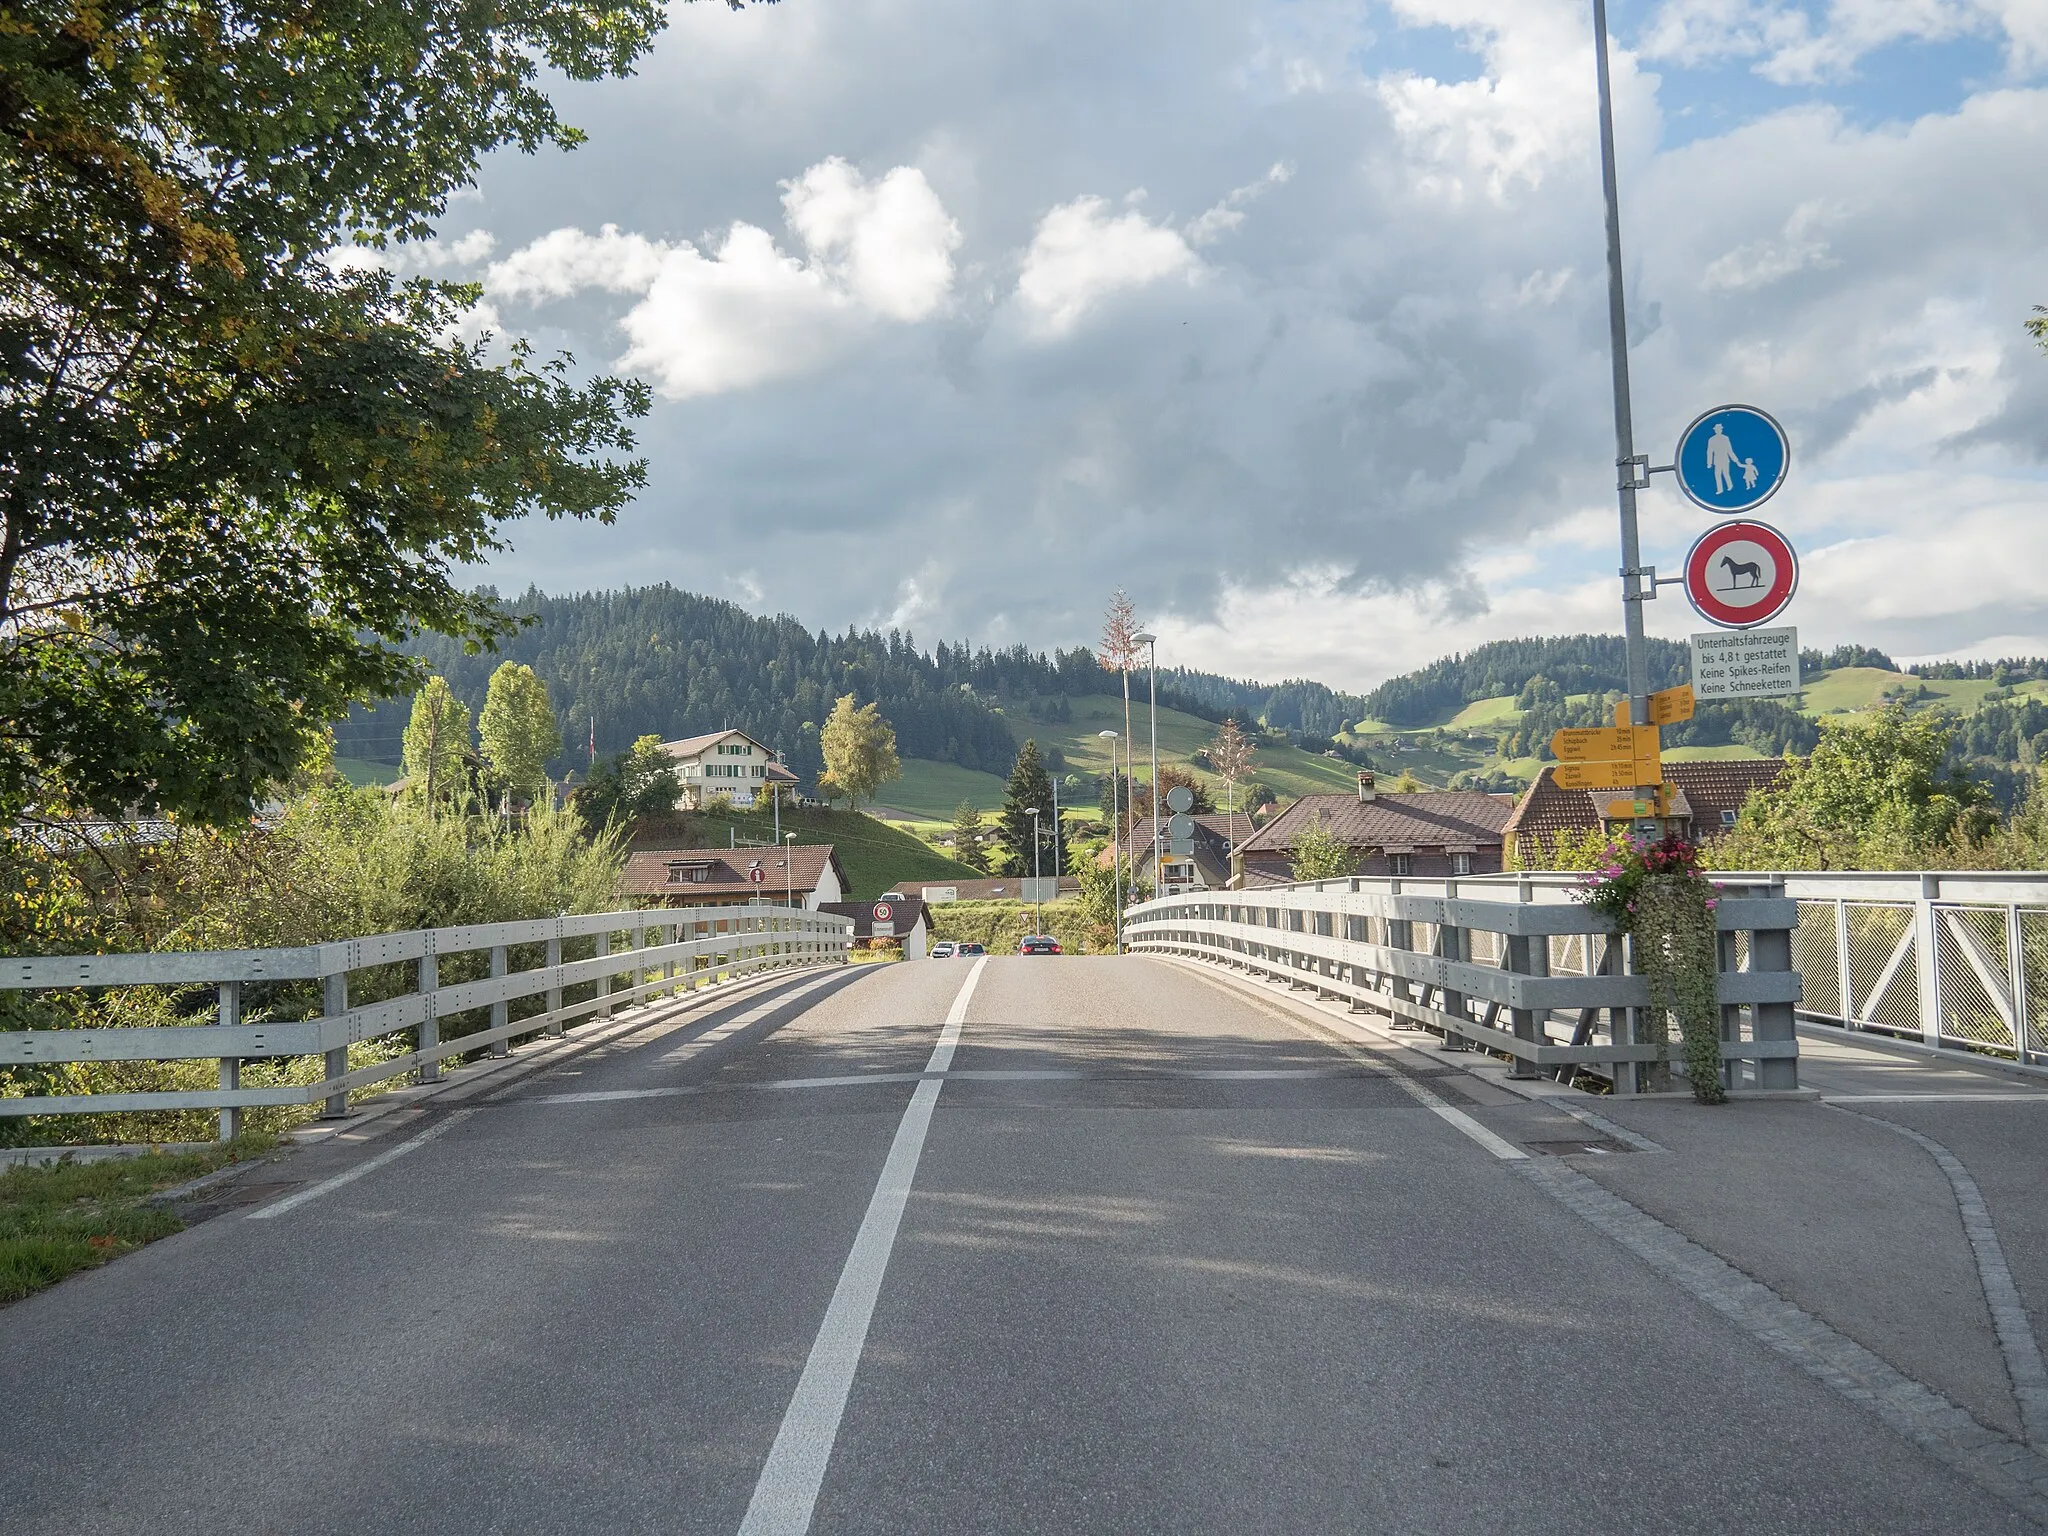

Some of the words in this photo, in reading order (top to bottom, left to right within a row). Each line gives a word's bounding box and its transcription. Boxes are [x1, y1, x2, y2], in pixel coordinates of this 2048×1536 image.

[1697, 635, 1790, 649] Unterhaltsfahrzeuge
[1702, 654, 1715, 664] bis
[1744, 649, 1787, 663] gestattet
[1700, 667, 1725, 679] Keine
[1729, 663, 1791, 679] Spikes-Reifen
[1701, 682, 1726, 694] Keine
[1730, 679, 1792, 692] Schneeketten
[879, 908, 887, 916] 50
